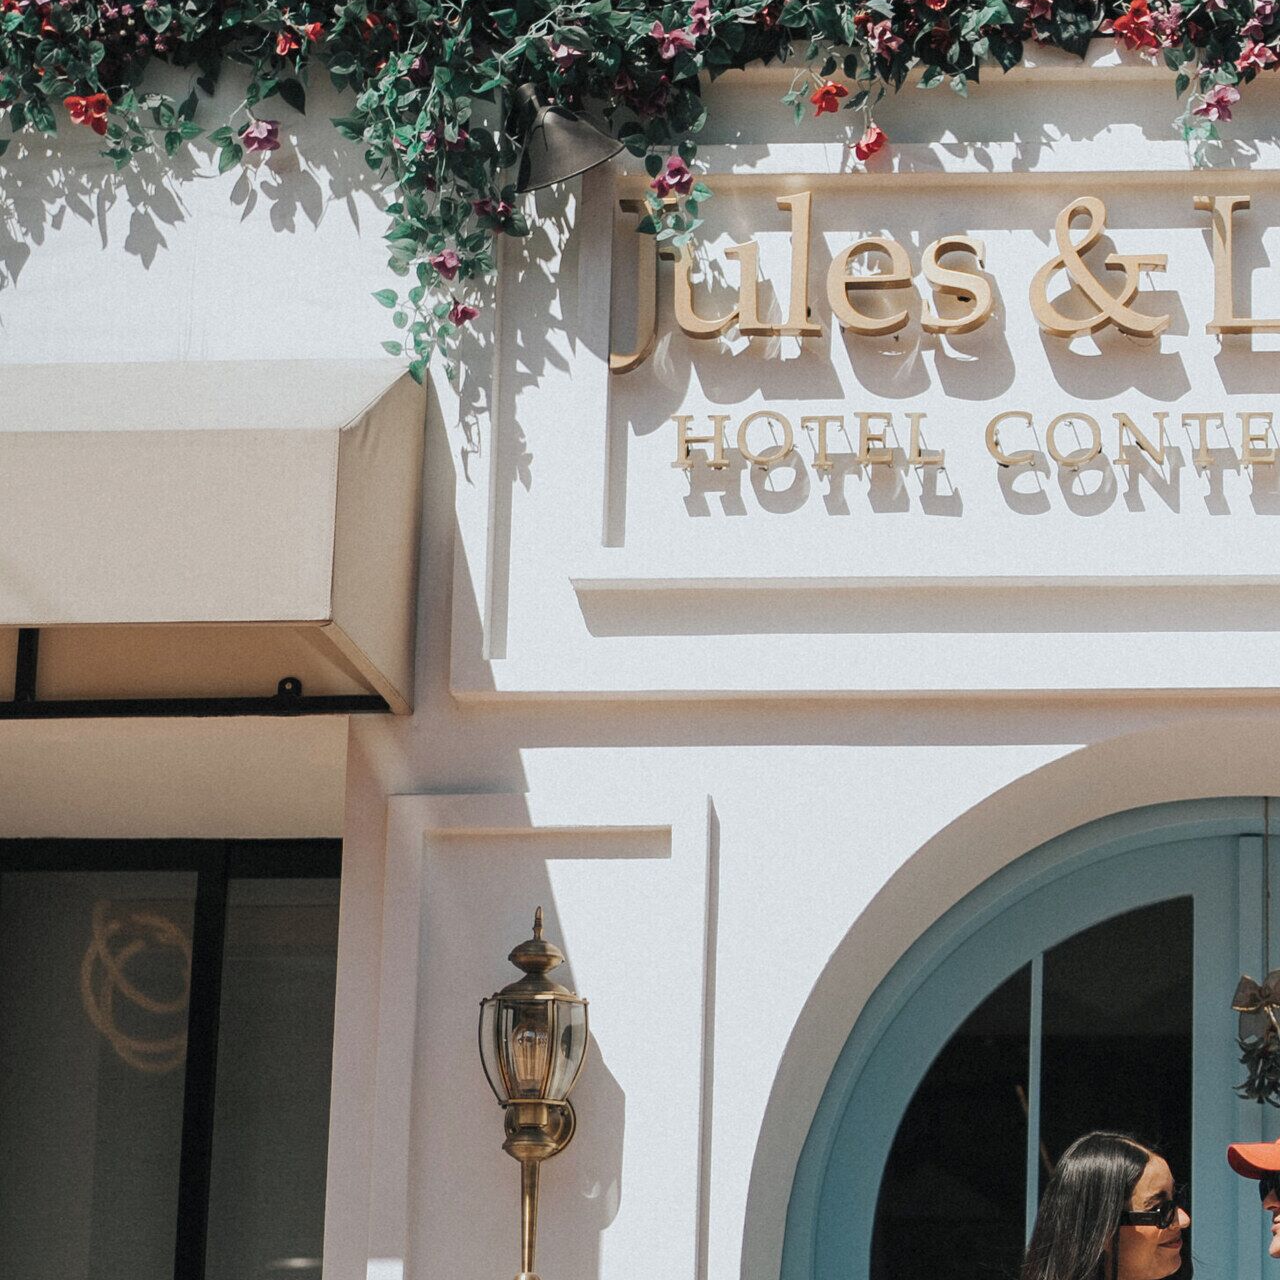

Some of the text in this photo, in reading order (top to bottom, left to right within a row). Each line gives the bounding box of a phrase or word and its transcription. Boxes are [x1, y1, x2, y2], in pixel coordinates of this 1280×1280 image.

[609, 191, 995, 374] Jules
[1029, 195, 1170, 338] &
[670, 410, 946, 470] HOTEL
